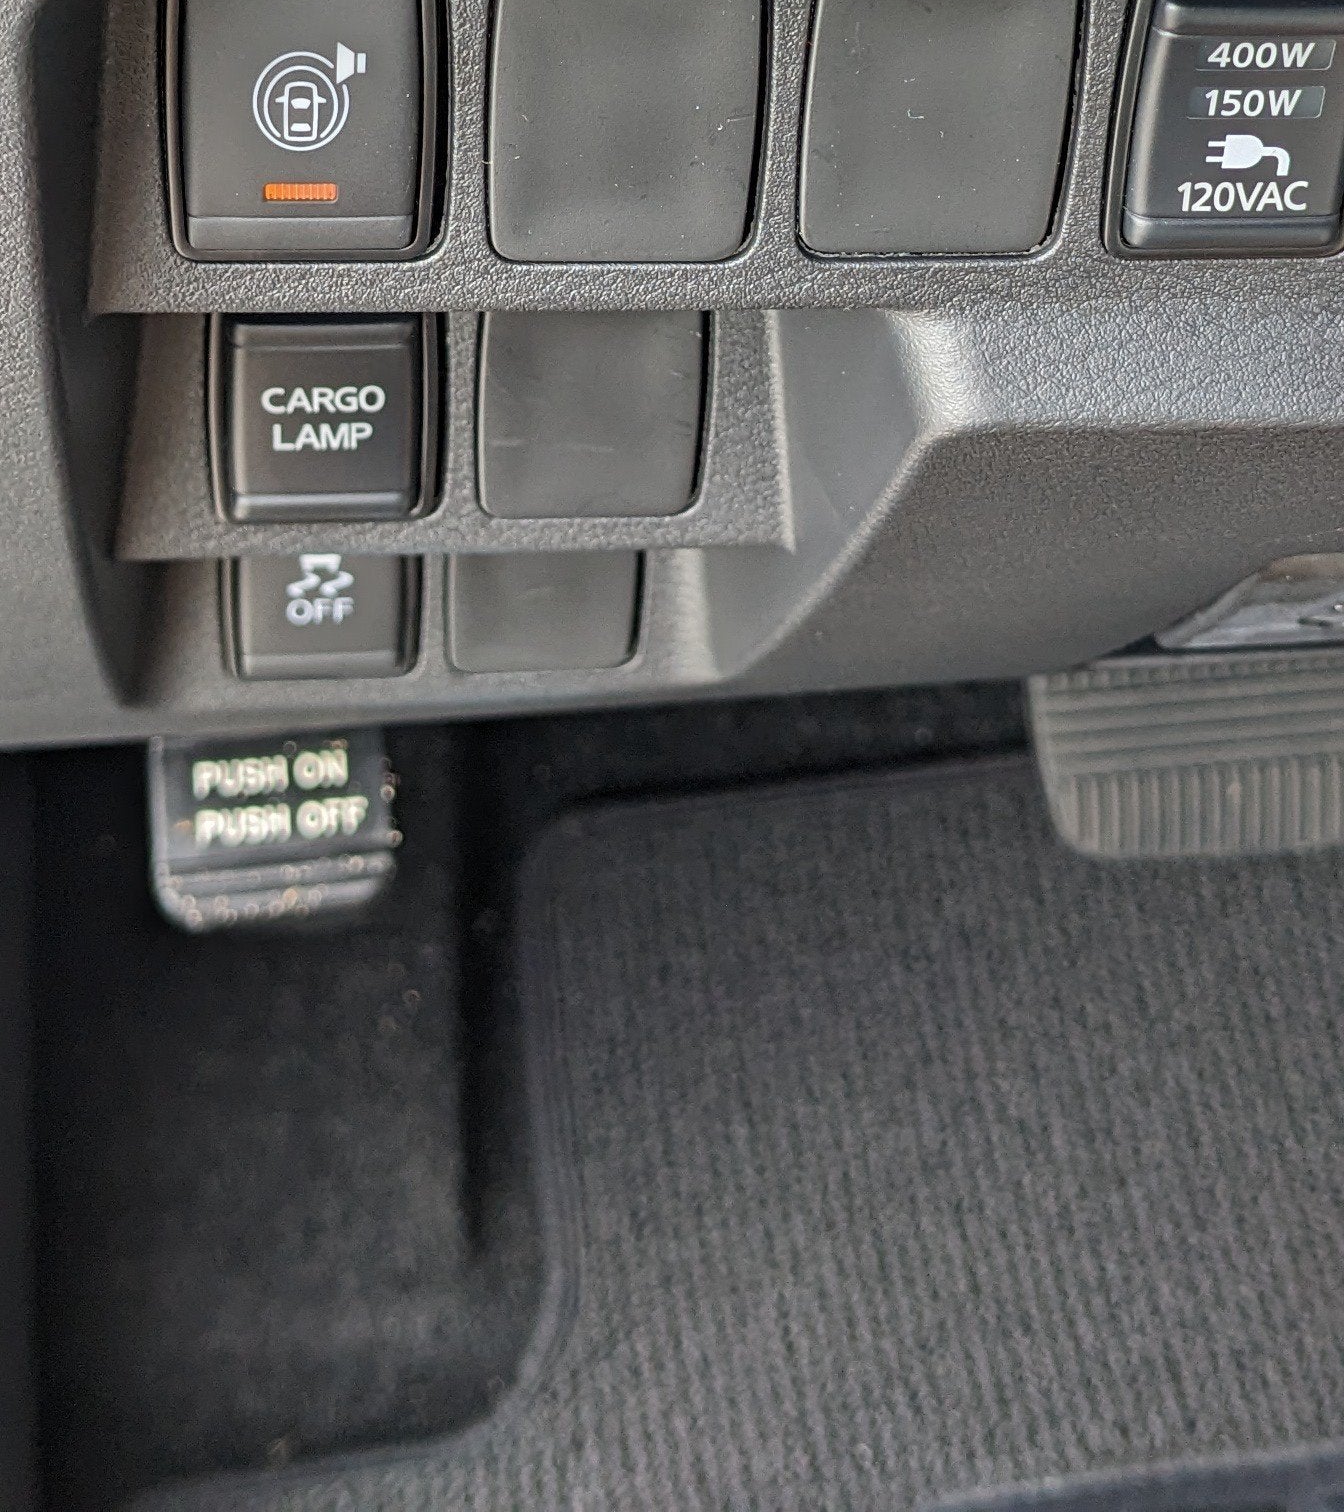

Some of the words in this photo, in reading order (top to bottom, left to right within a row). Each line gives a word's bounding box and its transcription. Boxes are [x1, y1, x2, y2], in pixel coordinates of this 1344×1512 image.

[1207, 41, 1317, 69] 400W
[1204, 89, 1303, 117] 150W
[1176, 180, 1310, 212] 120VAC
[260, 385, 386, 415] CARGO
[272, 422, 374, 452] LAMP
[286, 596, 355, 626] OFF
[191, 753, 290, 800] PUSH
[293, 747, 349, 790] ON
[193, 802, 292, 846] PUSH
[296, 795, 369, 839] OFF
